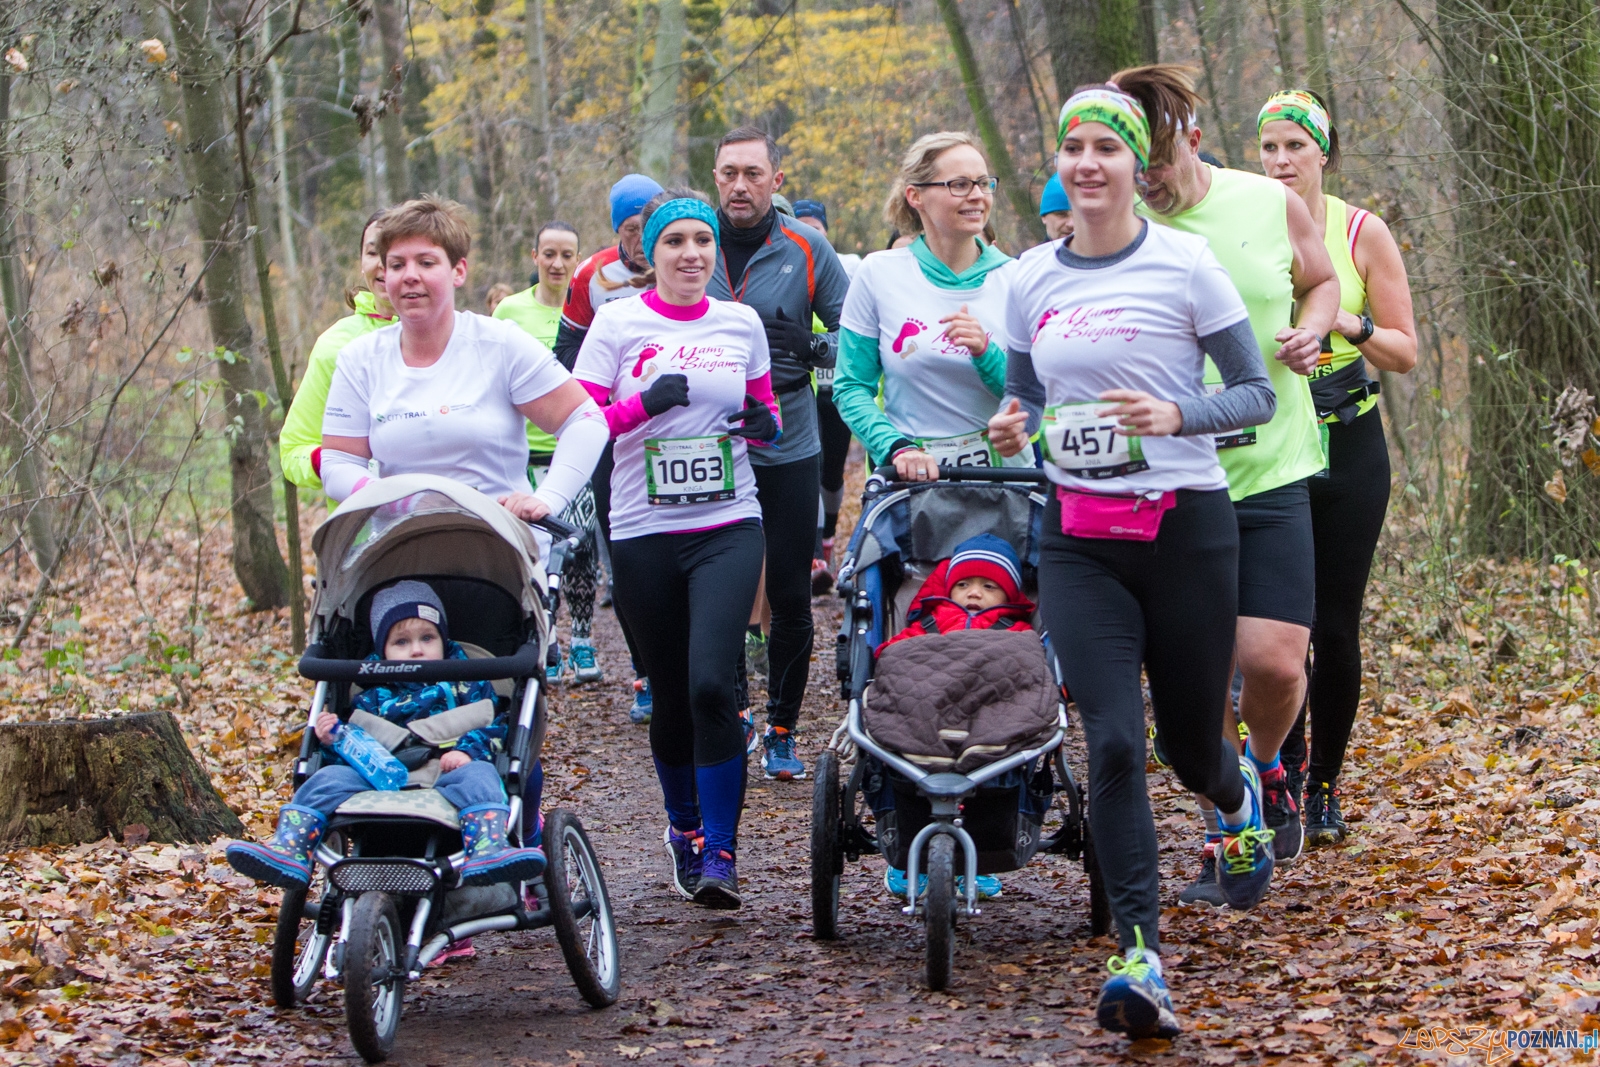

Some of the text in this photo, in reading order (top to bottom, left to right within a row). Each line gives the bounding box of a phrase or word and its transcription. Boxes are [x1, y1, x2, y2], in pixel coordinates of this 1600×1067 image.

[1057, 306, 1125, 327] Mamy
[669, 346, 725, 362] Mamy
[1061, 424, 1117, 457] 457
[657, 456, 724, 484] 1063
[683, 485, 704, 493] KINGA
[358, 662, 422, 675] X-lander
